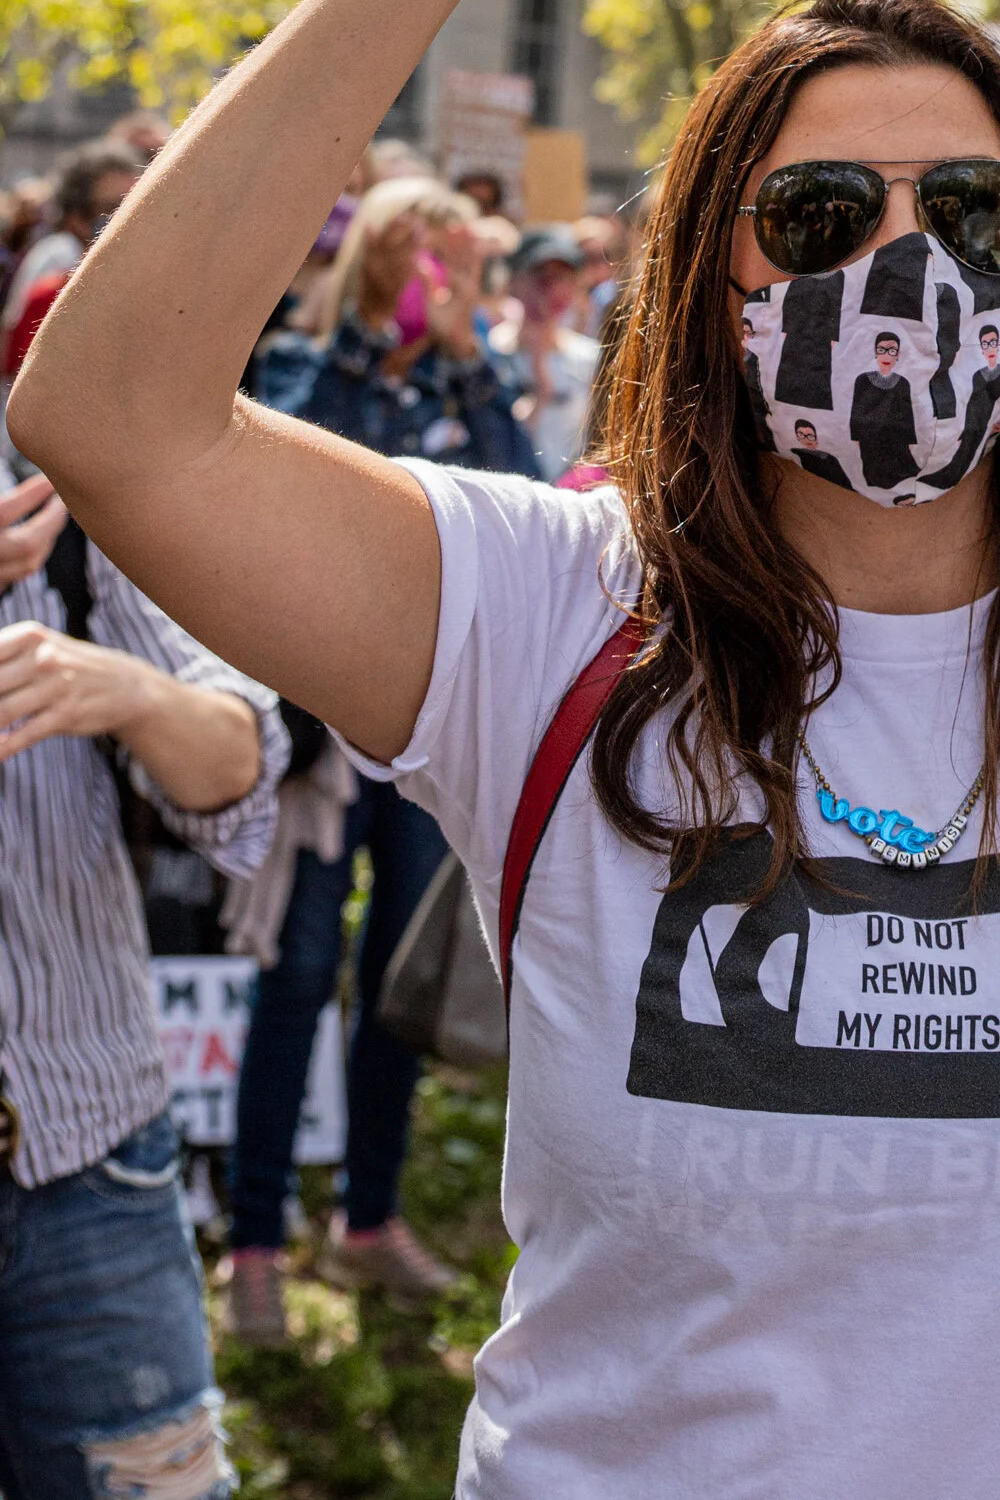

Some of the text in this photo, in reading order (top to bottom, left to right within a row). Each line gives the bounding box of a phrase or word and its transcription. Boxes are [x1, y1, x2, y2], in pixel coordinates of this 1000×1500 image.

[816, 788, 932, 855] vote
[873, 817, 967, 864] FEMINIST
[866, 914, 969, 951] DO NOT
[862, 962, 977, 995] REWIND
[835, 1010, 1000, 1050] MY RIGHTS
